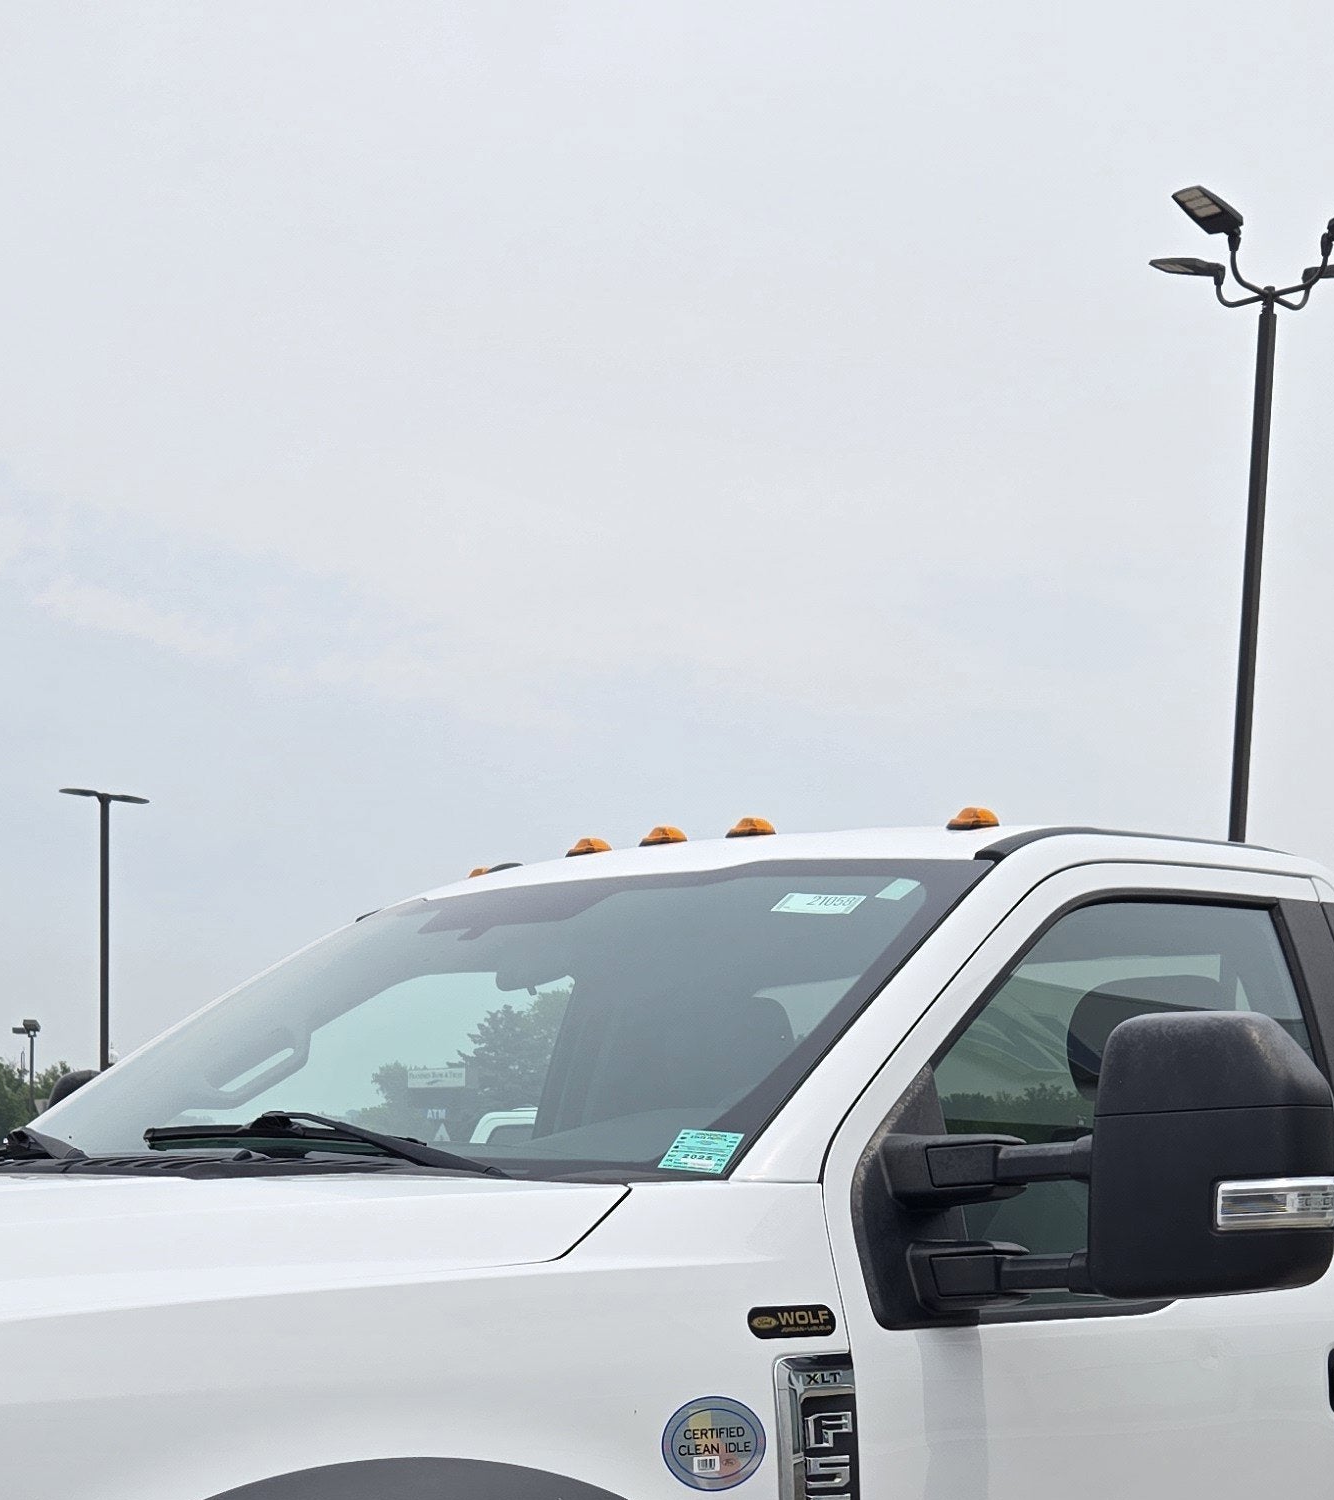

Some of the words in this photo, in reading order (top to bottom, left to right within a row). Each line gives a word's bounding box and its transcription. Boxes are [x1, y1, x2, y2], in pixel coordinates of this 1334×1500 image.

[427, 1109, 446, 1119] ATM
[681, 1153, 713, 1161] 2025
[777, 1310, 830, 1326] WOLF
[805, 1371, 841, 1385] XLT
[683, 1426, 745, 1440] CERTIFIED
[678, 1443, 720, 1456] CLEAN
[725, 1441, 752, 1454] IDLE
